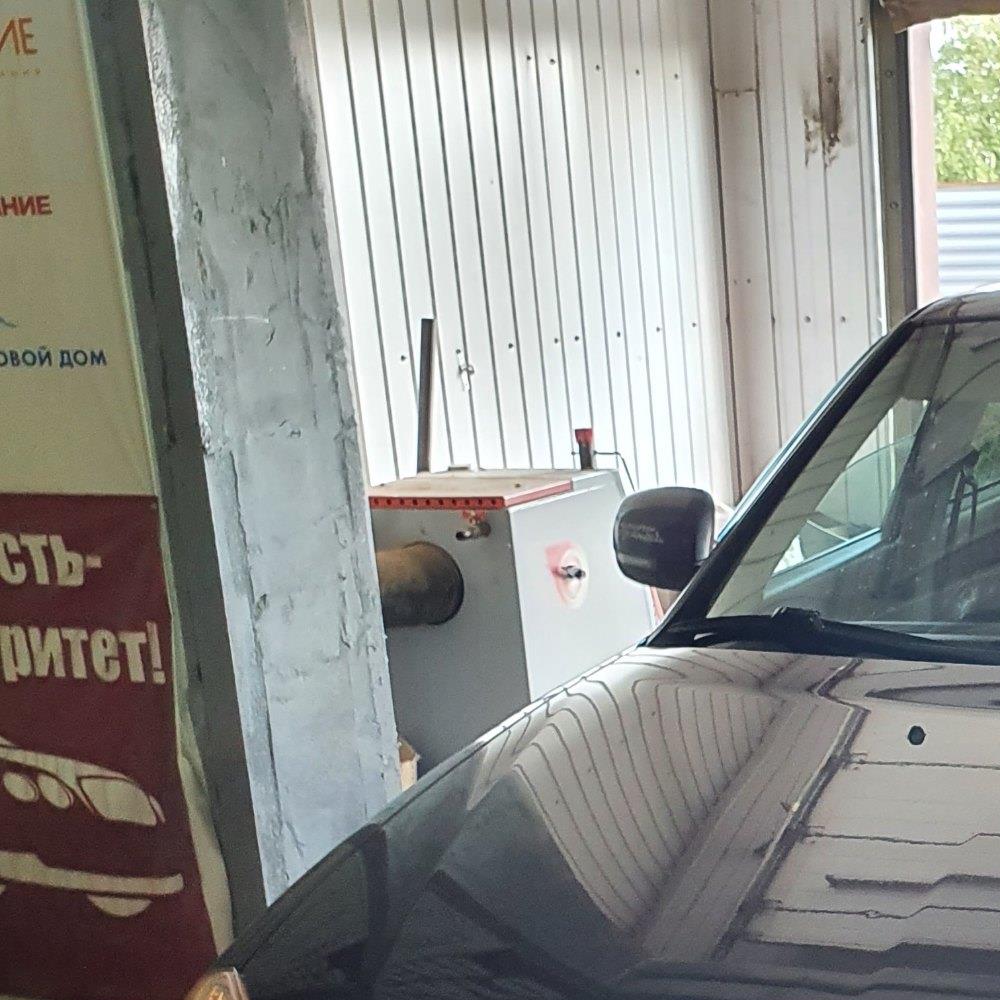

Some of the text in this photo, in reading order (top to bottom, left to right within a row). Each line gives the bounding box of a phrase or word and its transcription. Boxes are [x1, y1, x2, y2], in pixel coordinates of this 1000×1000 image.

[0, 195, 52, 216] НИЕ
[59, 349, 108, 369] ДОМ
[0, 620, 166, 685] ритет!
